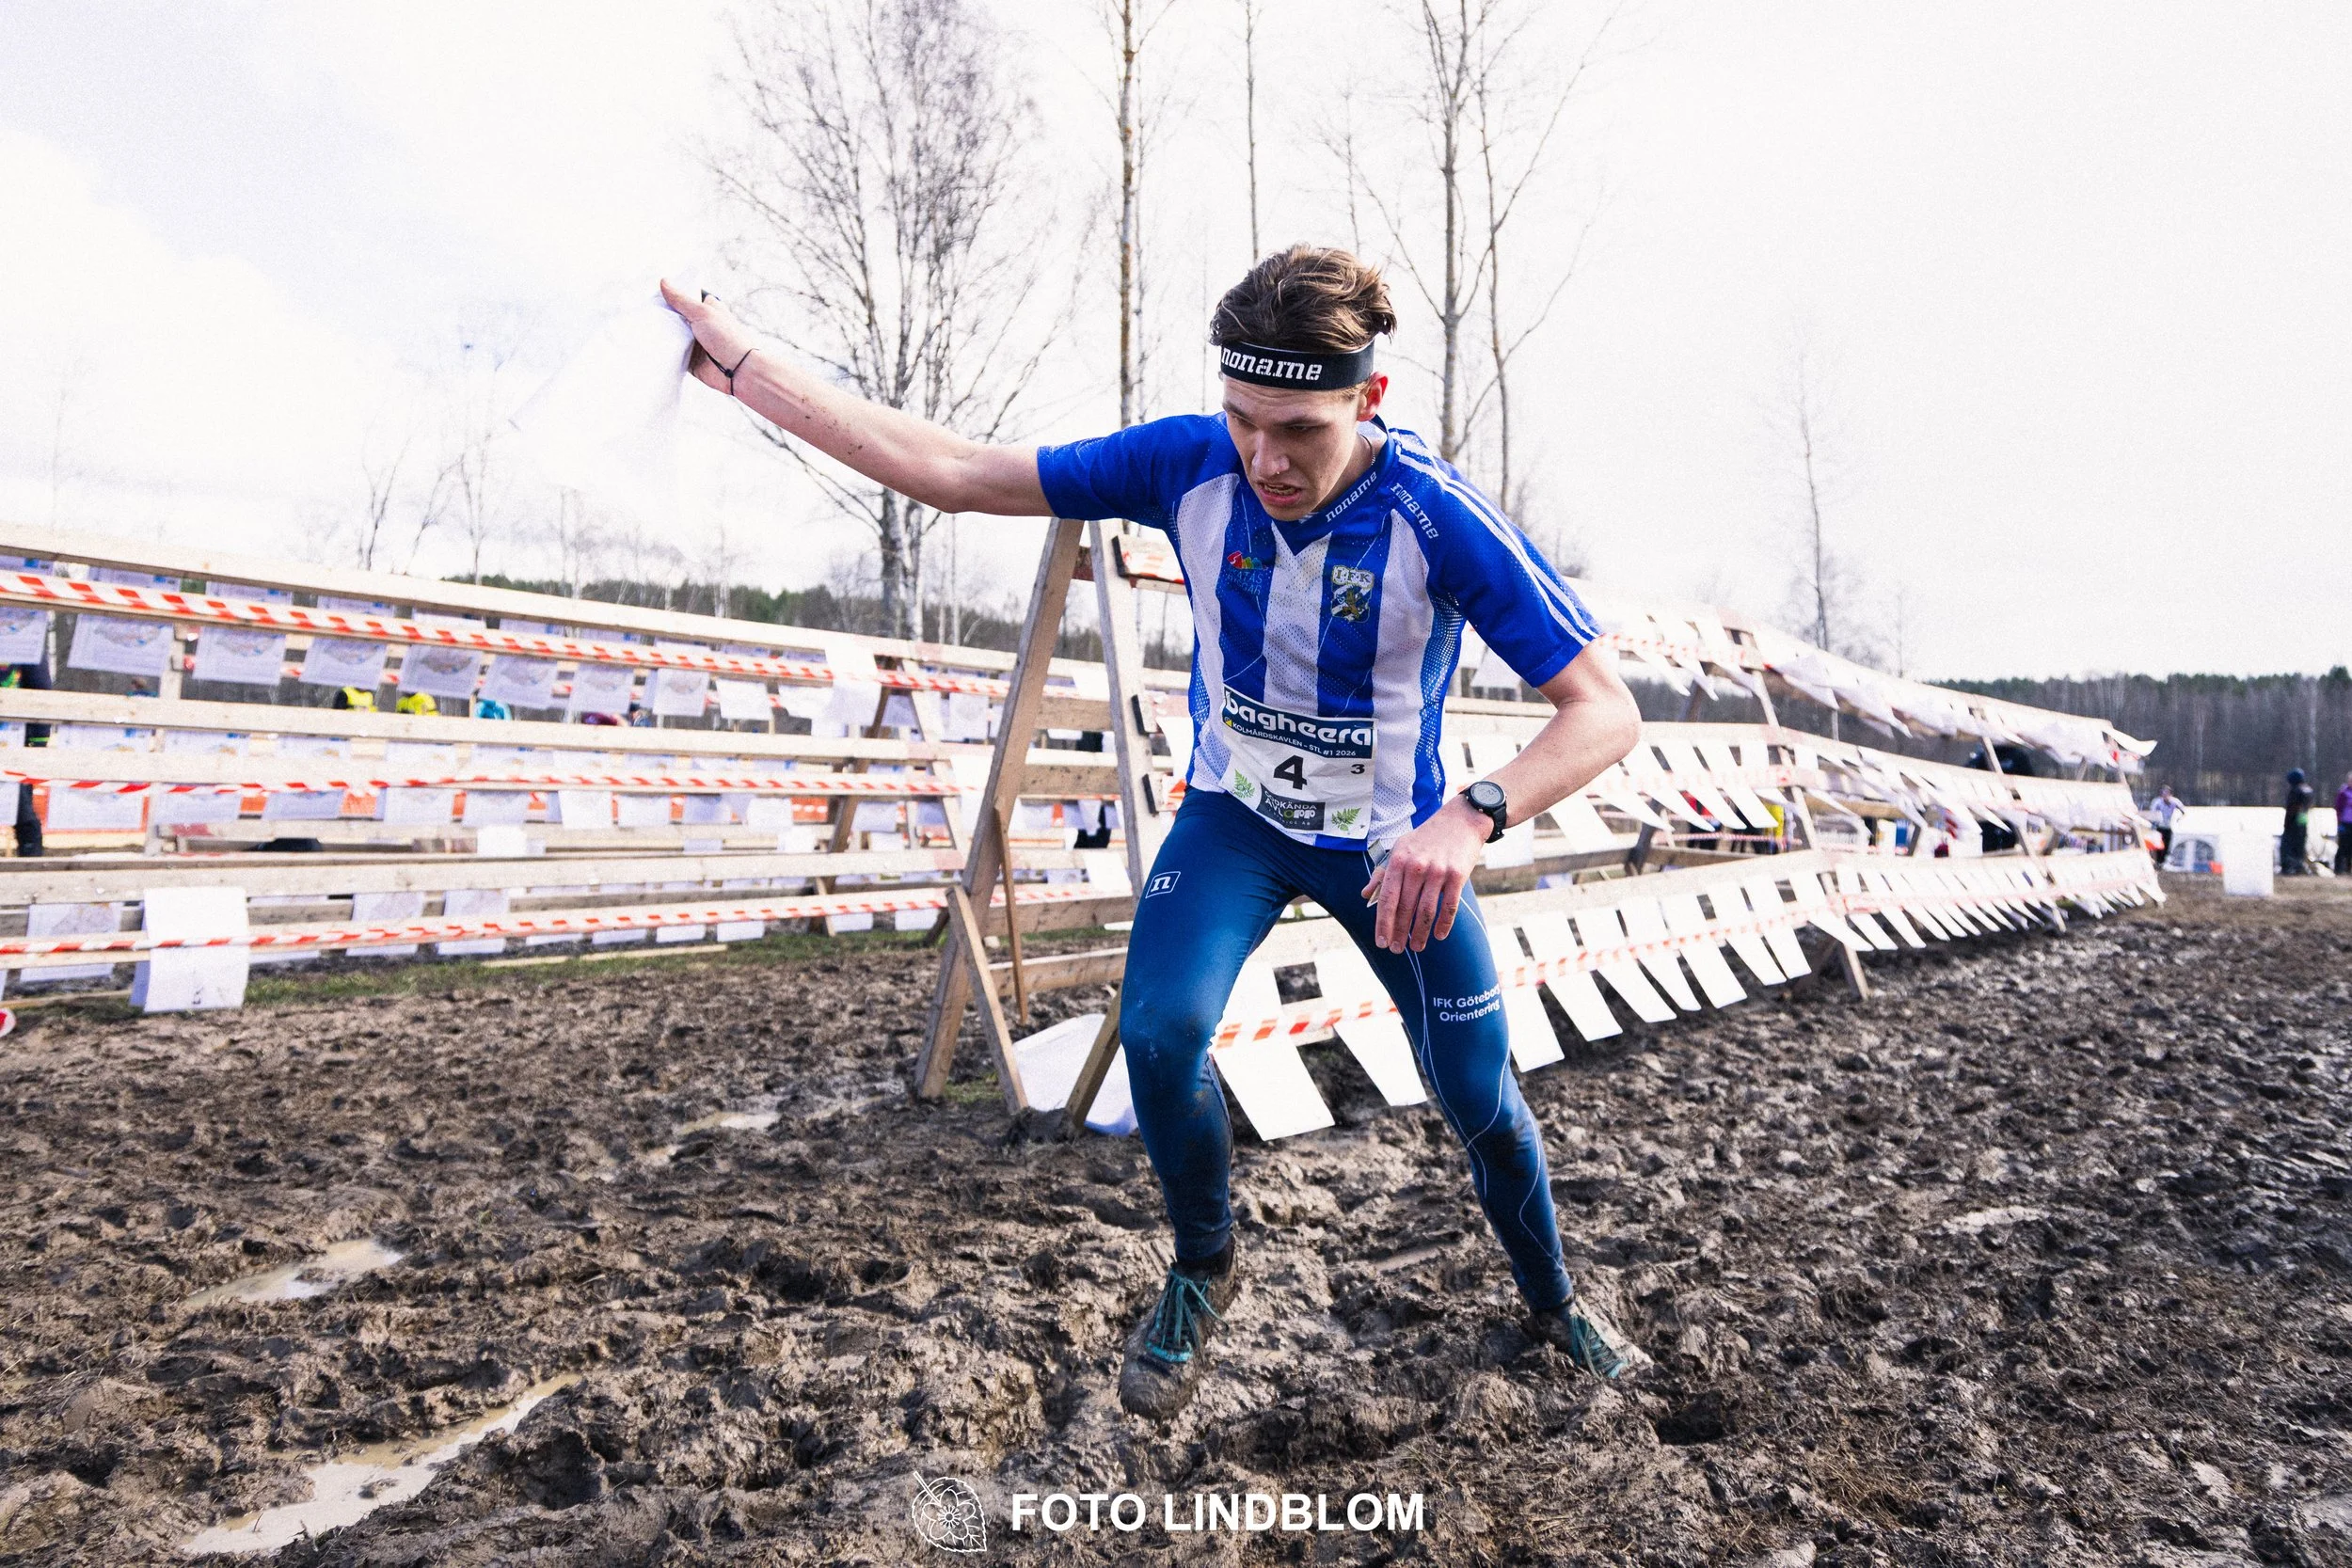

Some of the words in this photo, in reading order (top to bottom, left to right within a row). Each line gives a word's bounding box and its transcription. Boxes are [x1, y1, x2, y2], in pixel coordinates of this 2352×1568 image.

[1221, 347, 1322, 381] noname
[1325, 471, 1377, 523] noname
[1225, 691, 1372, 746] bagheera
[1232, 723, 1302, 747] KOLMÅRDSKAVLEN
[1309, 744, 1322, 754] STL
[1273, 754, 1308, 790] 4
[1350, 763, 1365, 775] 3
[1433, 997, 1453, 1008] IFK
[1439, 1000, 1500, 1022] Orientering
